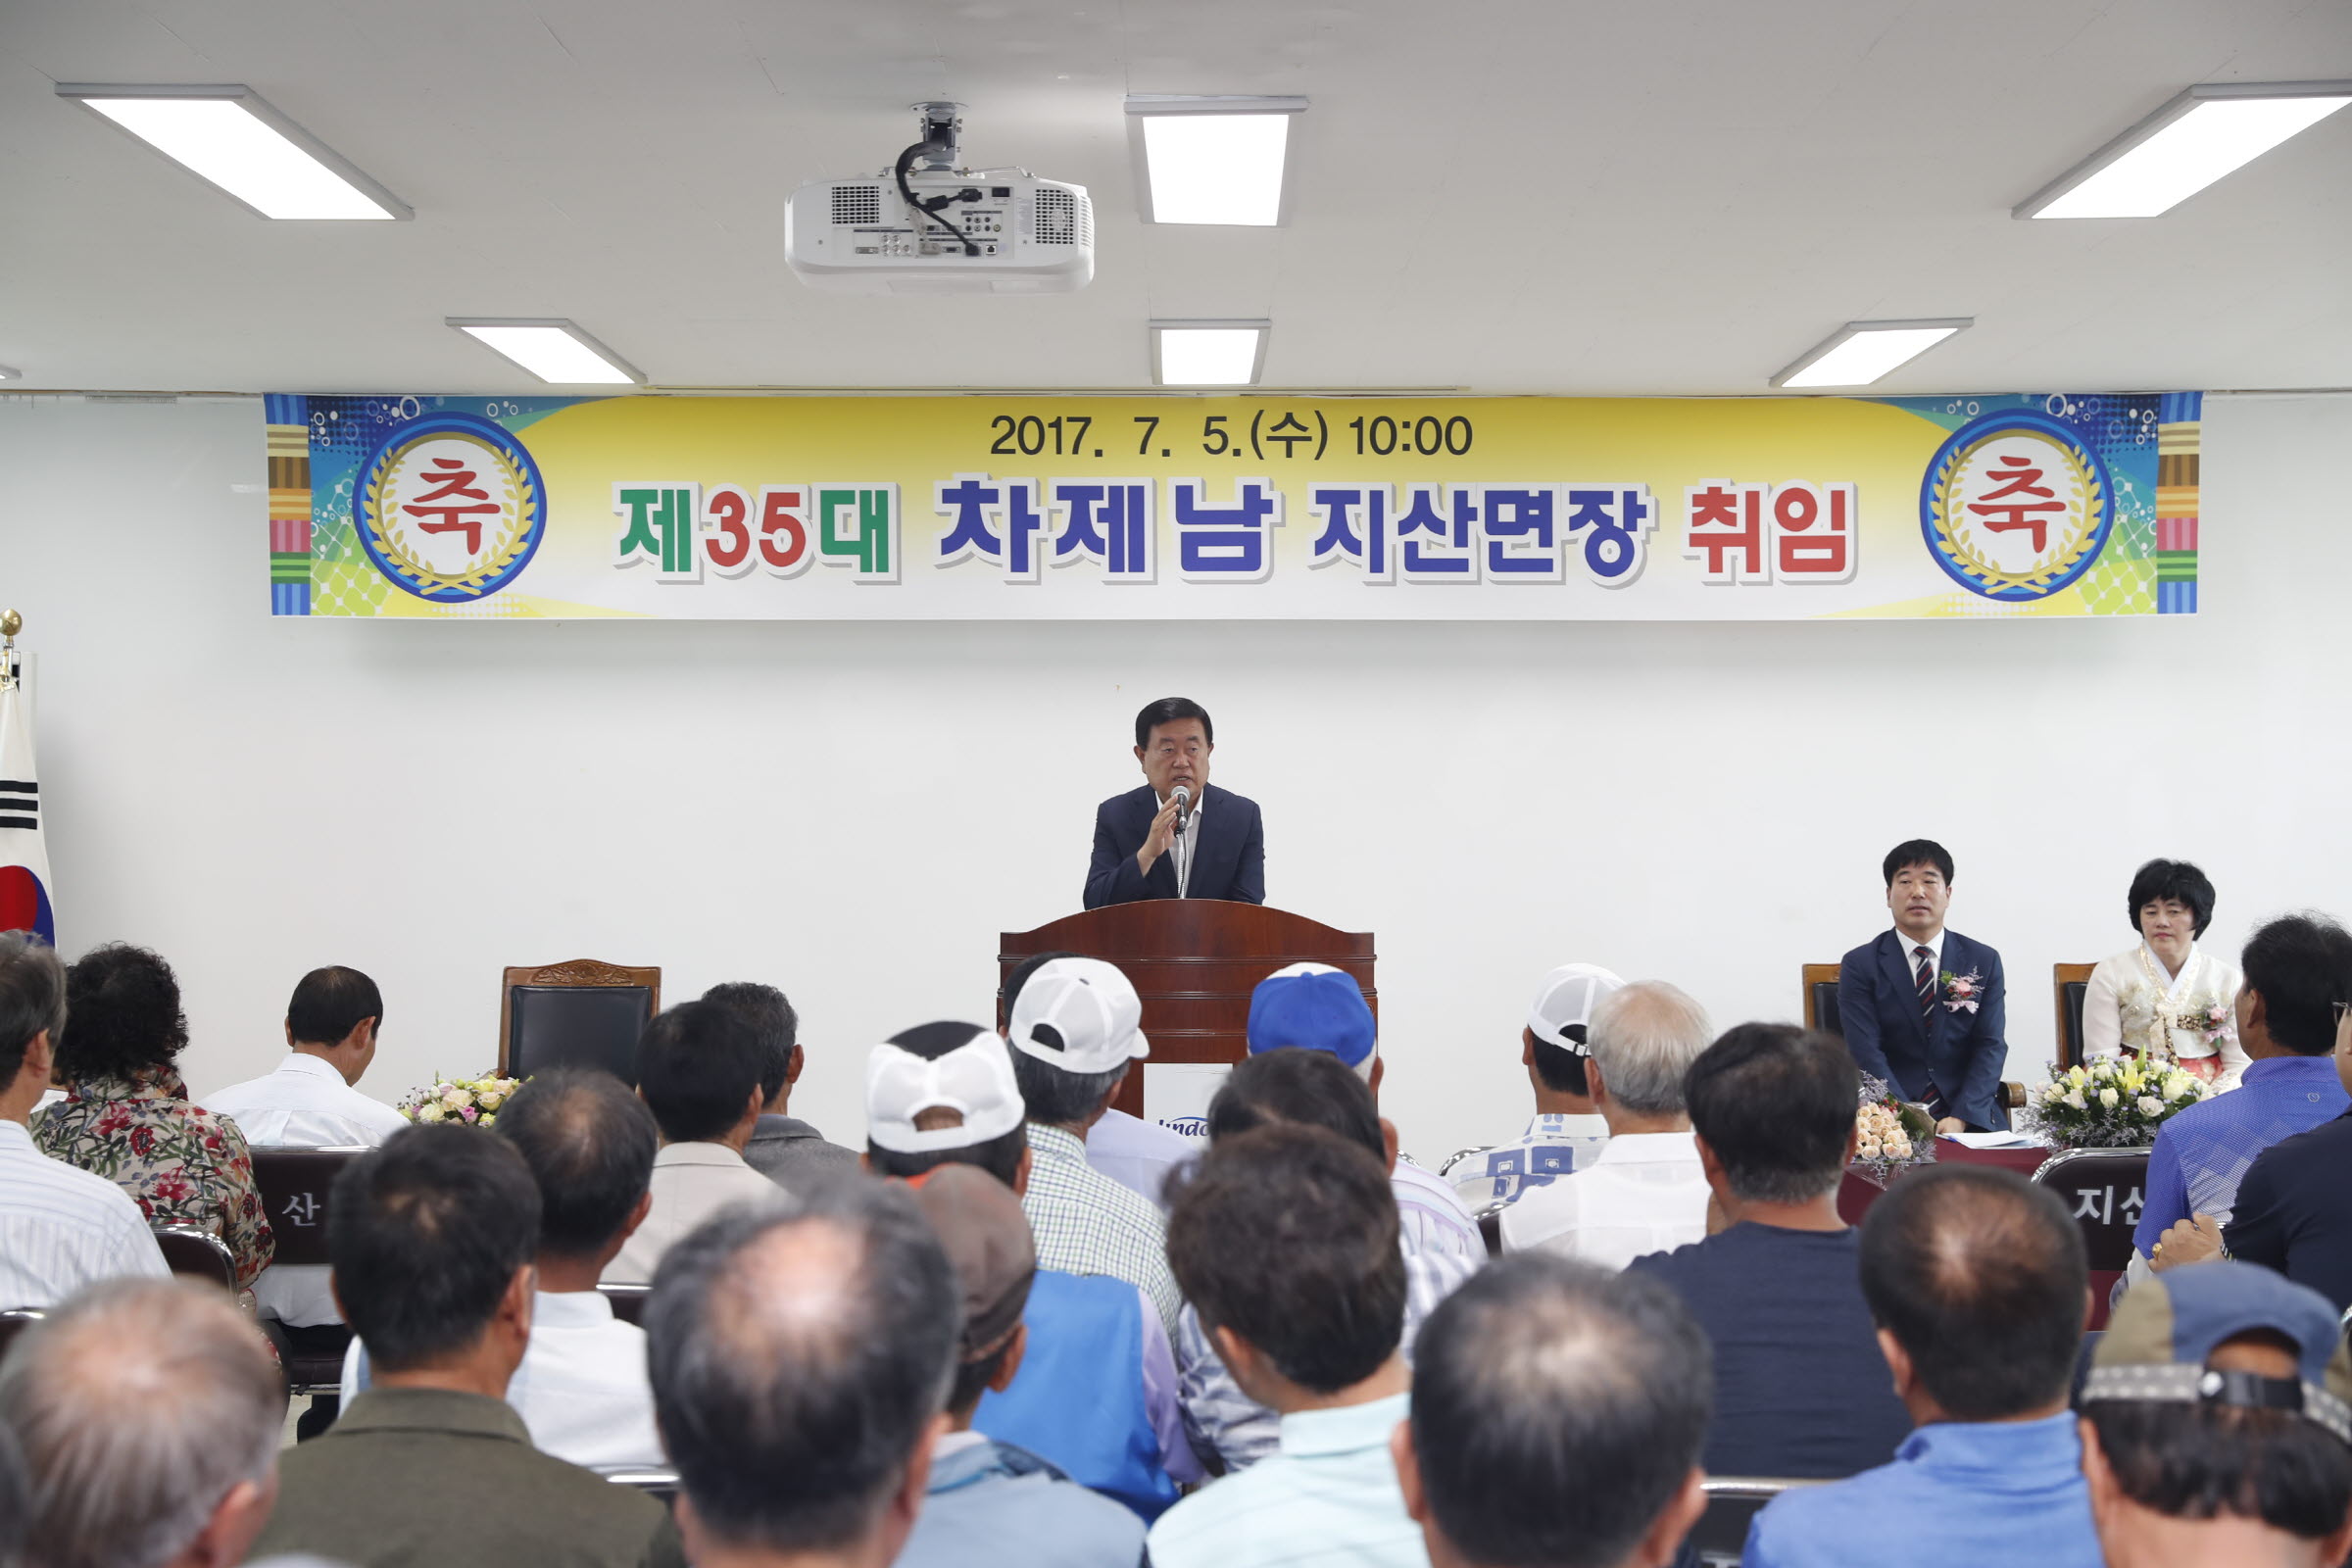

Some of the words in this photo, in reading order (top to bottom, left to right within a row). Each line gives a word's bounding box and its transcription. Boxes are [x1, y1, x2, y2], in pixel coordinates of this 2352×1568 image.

[990, 415, 1103, 458] 2017.
[1133, 416, 1171, 458] 7.
[1202, 409, 1328, 461] 5.(수)
[1348, 416, 1473, 456] 10:00
[404, 458, 501, 556] 축
[617, 488, 890, 574] 제35대
[941, 480, 1274, 574] 차제남
[1313, 488, 1649, 578] 지산면장
[1688, 485, 1847, 574] 취임
[1968, 455, 2067, 554] 축
